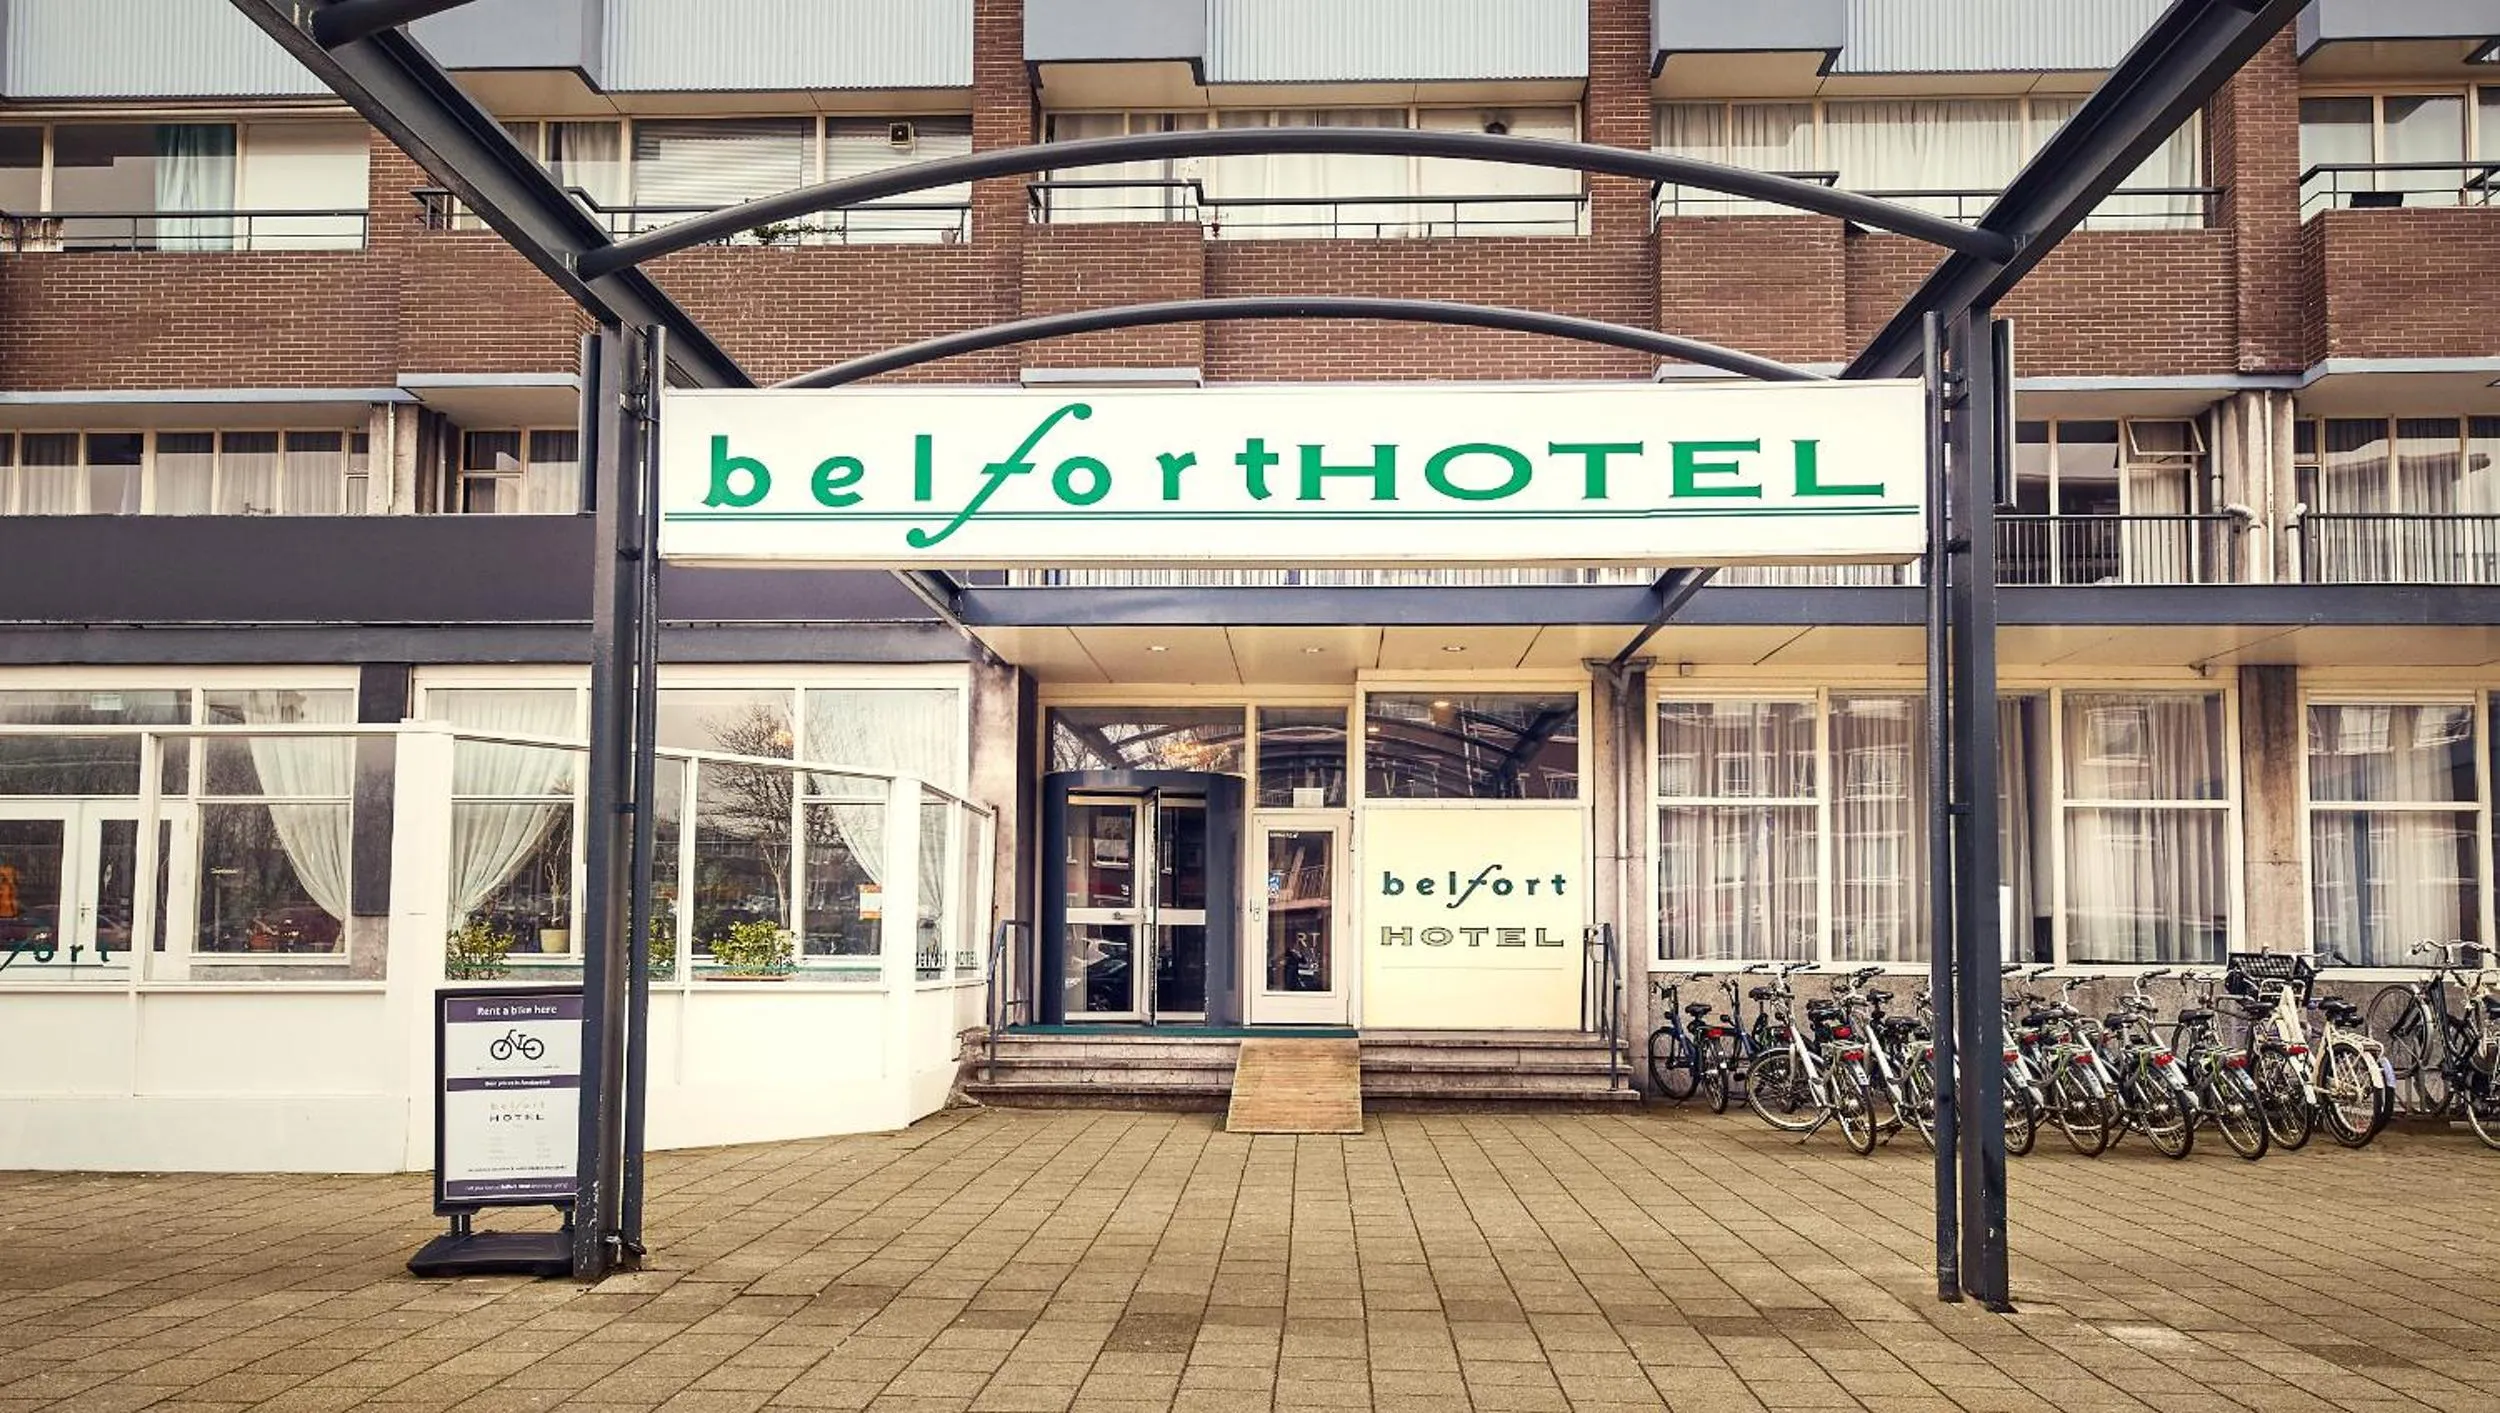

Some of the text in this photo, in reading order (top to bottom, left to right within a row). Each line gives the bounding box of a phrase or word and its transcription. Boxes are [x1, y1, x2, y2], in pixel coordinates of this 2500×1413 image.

[1297, 437, 1886, 501] HOTEL
[1381, 864, 1568, 909] belfort
[1380, 926, 1565, 948] HOTEL
[477, 1004, 557, 1016] Rent a bike here
[489, 1113, 545, 1123] HOTEL
